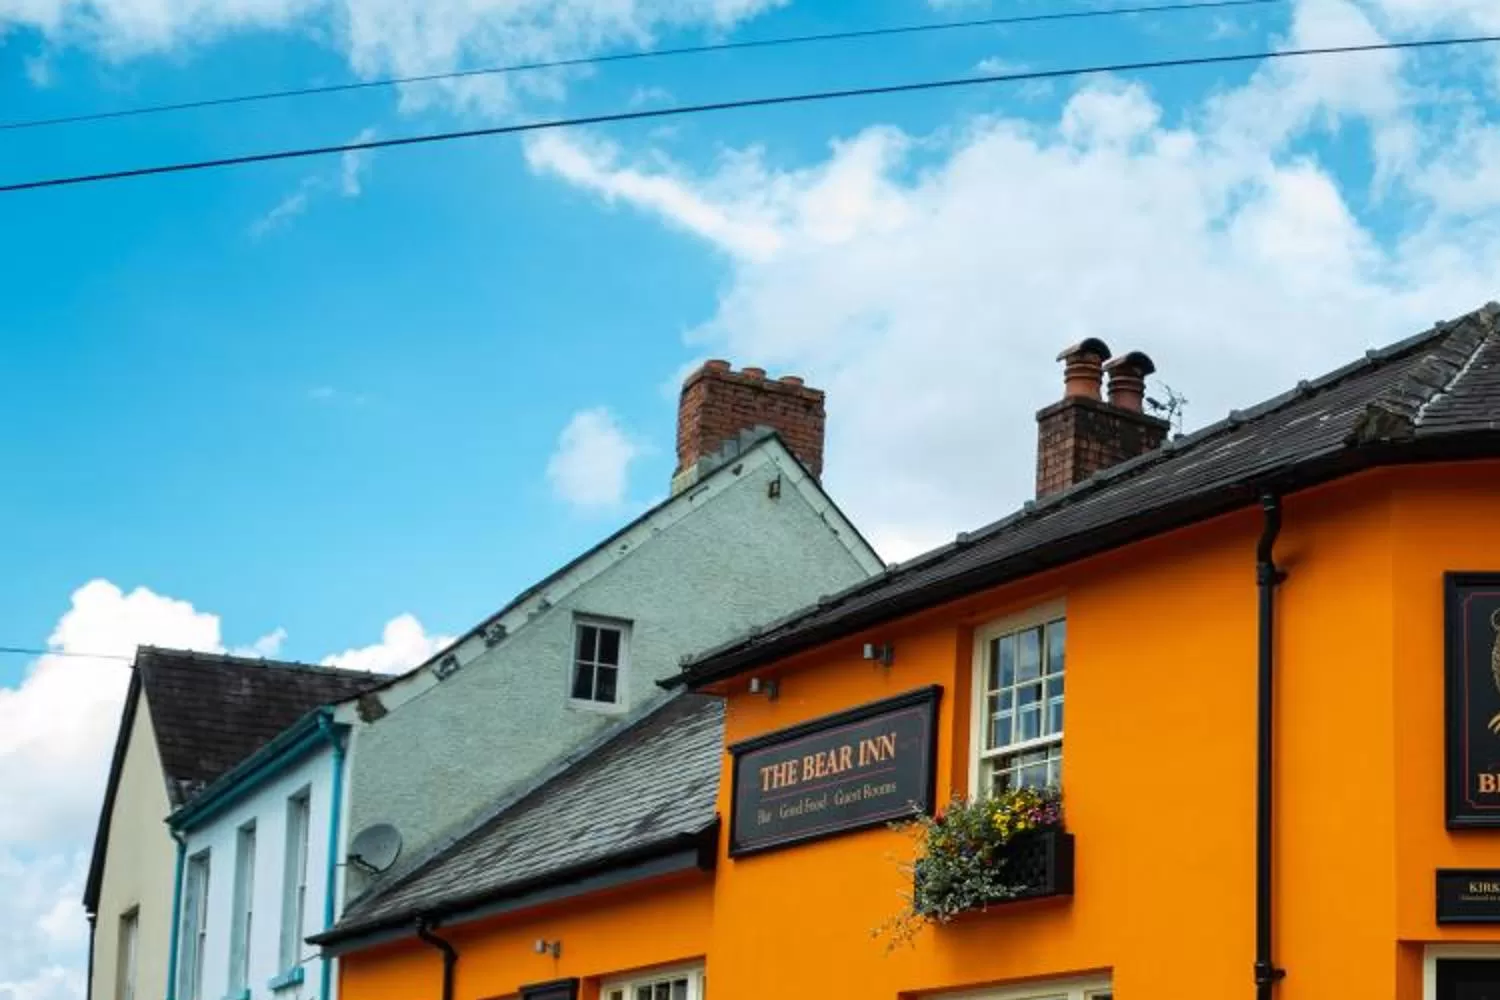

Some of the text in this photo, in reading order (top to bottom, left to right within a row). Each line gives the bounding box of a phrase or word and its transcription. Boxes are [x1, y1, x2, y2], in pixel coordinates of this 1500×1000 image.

[760, 732, 897, 792] THE BEAR INN
[863, 781, 897, 800] Rooms
[1469, 882, 1499, 893] KIRK
